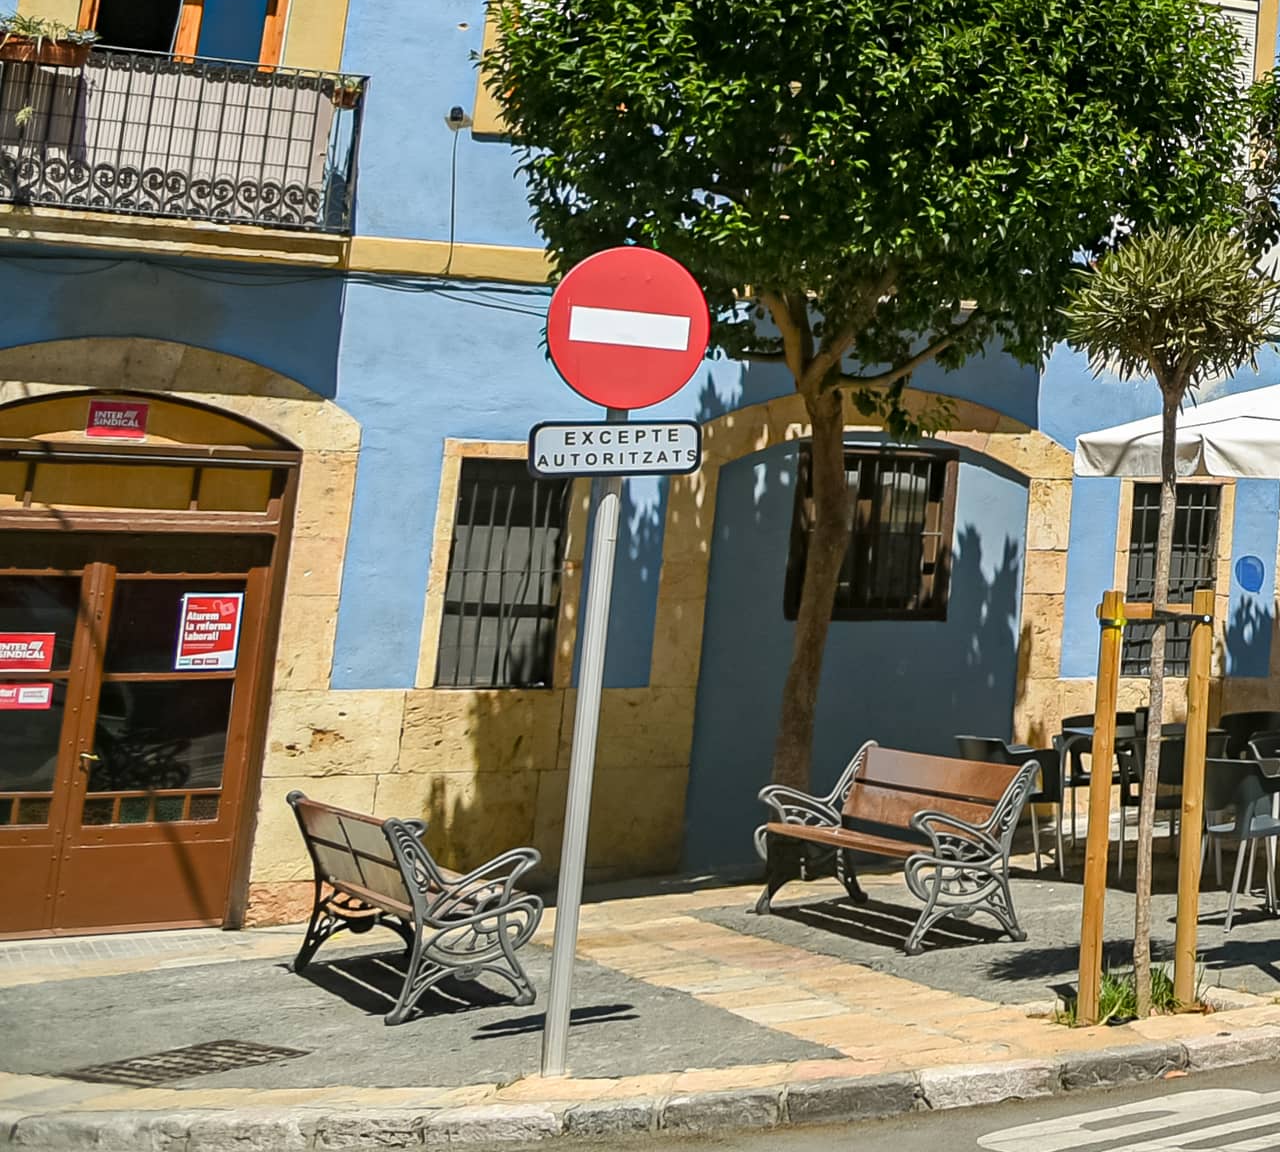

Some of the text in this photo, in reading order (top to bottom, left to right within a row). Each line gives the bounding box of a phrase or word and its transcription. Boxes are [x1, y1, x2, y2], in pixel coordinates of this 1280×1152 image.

[95, 410, 123, 418] INTER
[94, 418, 140, 427] SINDICAL
[564, 428, 679, 445] EXCEPTE
[537, 449, 697, 467] AUTORITZATS
[196, 621, 232, 631] reforma
